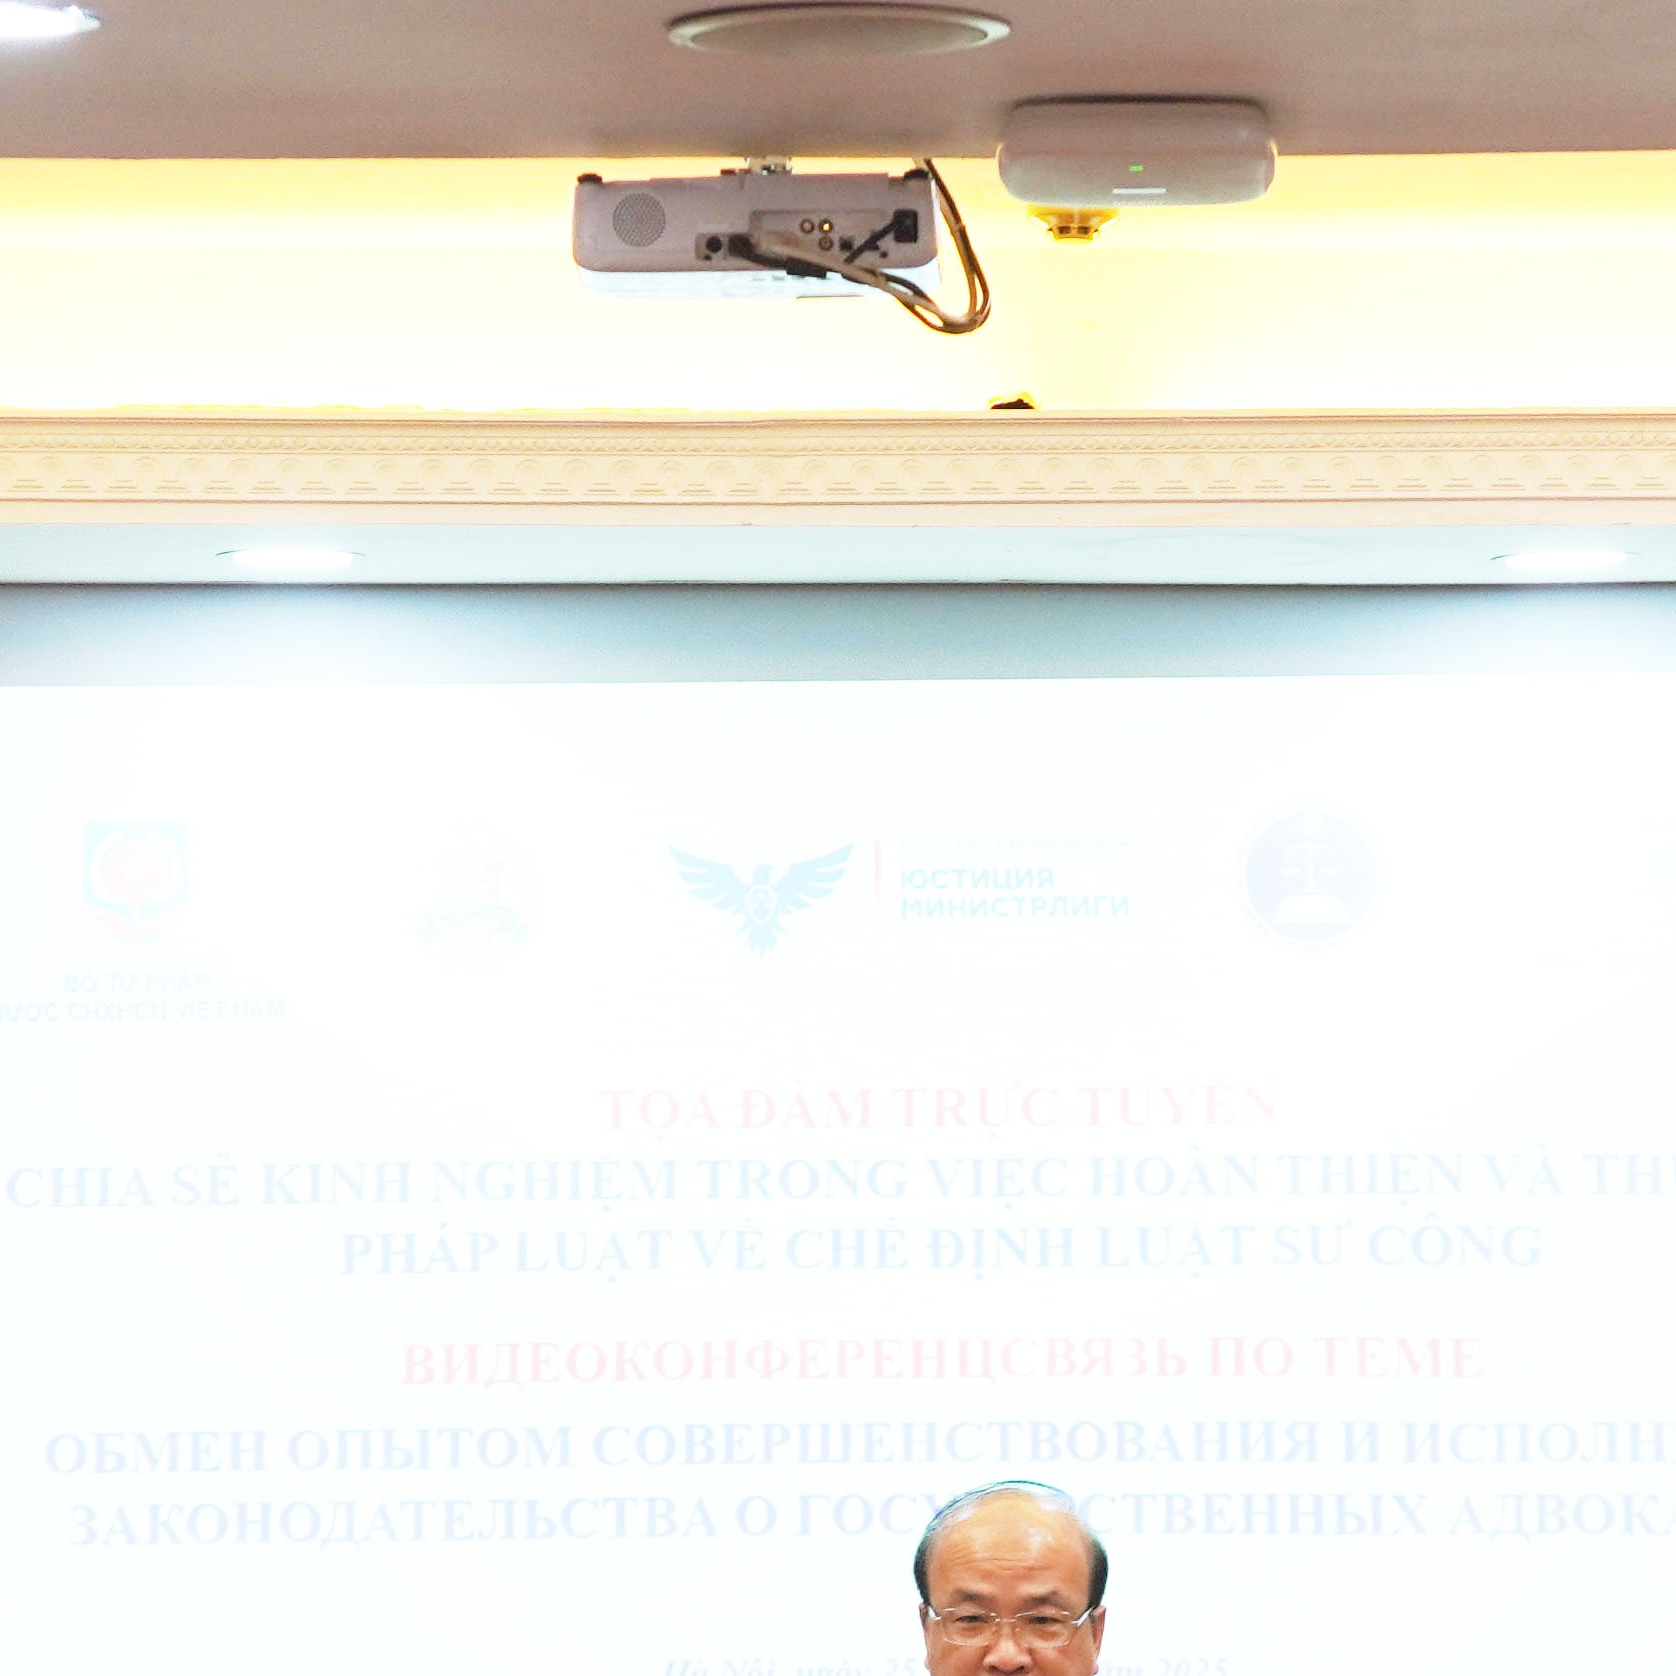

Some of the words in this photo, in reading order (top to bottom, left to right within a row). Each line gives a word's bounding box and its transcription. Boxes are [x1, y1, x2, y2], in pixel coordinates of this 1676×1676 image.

[899, 894, 1131, 920] МИНИСТРЛИГИ
[900, 866, 1056, 892] ЮСТИЦИЯ
[600, 1090, 720, 1141] TỌA
[740, 1079, 871, 1129] ĐÀM
[892, 1082, 1058, 1139] TRỰC
[1077, 1074, 1274, 1126] TUYẾN
[5, 1165, 156, 1209] CHIA
[171, 1152, 241, 1207] SẺ
[260, 1160, 411, 1206] KINH
[431, 1155, 677, 1213] NGHIỆM
[694, 1158, 908, 1201] TRONG
[925, 1153, 1069, 1211] VIỆC
[1089, 1144, 1260, 1198] HOÀN
[1276, 1150, 1463, 1207] THIỆN
[1482, 1140, 1565, 1196] VÀ
[342, 1220, 499, 1275] PHÁP
[512, 1228, 673, 1285] LUẬT
[687, 1216, 767, 1272] VỀ
[784, 1216, 909, 1272] CHẾ
[925, 1226, 1076, 1281] ĐỊNH
[1095, 1224, 1256, 1279] LUẬT
[1272, 1218, 1354, 1266] SƯ
[1366, 1211, 1542, 1268] CÔNG
[402, 1337, 1188, 1391] ВИДЕОКОНФЕРЕНЦСВЯЗЬ
[1209, 1336, 1294, 1377] ПО
[1313, 1336, 1483, 1379] ТЕМЕ
[45, 1429, 267, 1474] ОБМЕН
[287, 1425, 574, 1471] ОПЫТОМ
[592, 1417, 1321, 1467] СОВЕРШЕНСТВОВАНИЯ
[1340, 1420, 1380, 1464] И
[71, 1495, 719, 1552] ЗАКОНОДАТЕЛЬСТВА
[735, 1494, 778, 1537] О
